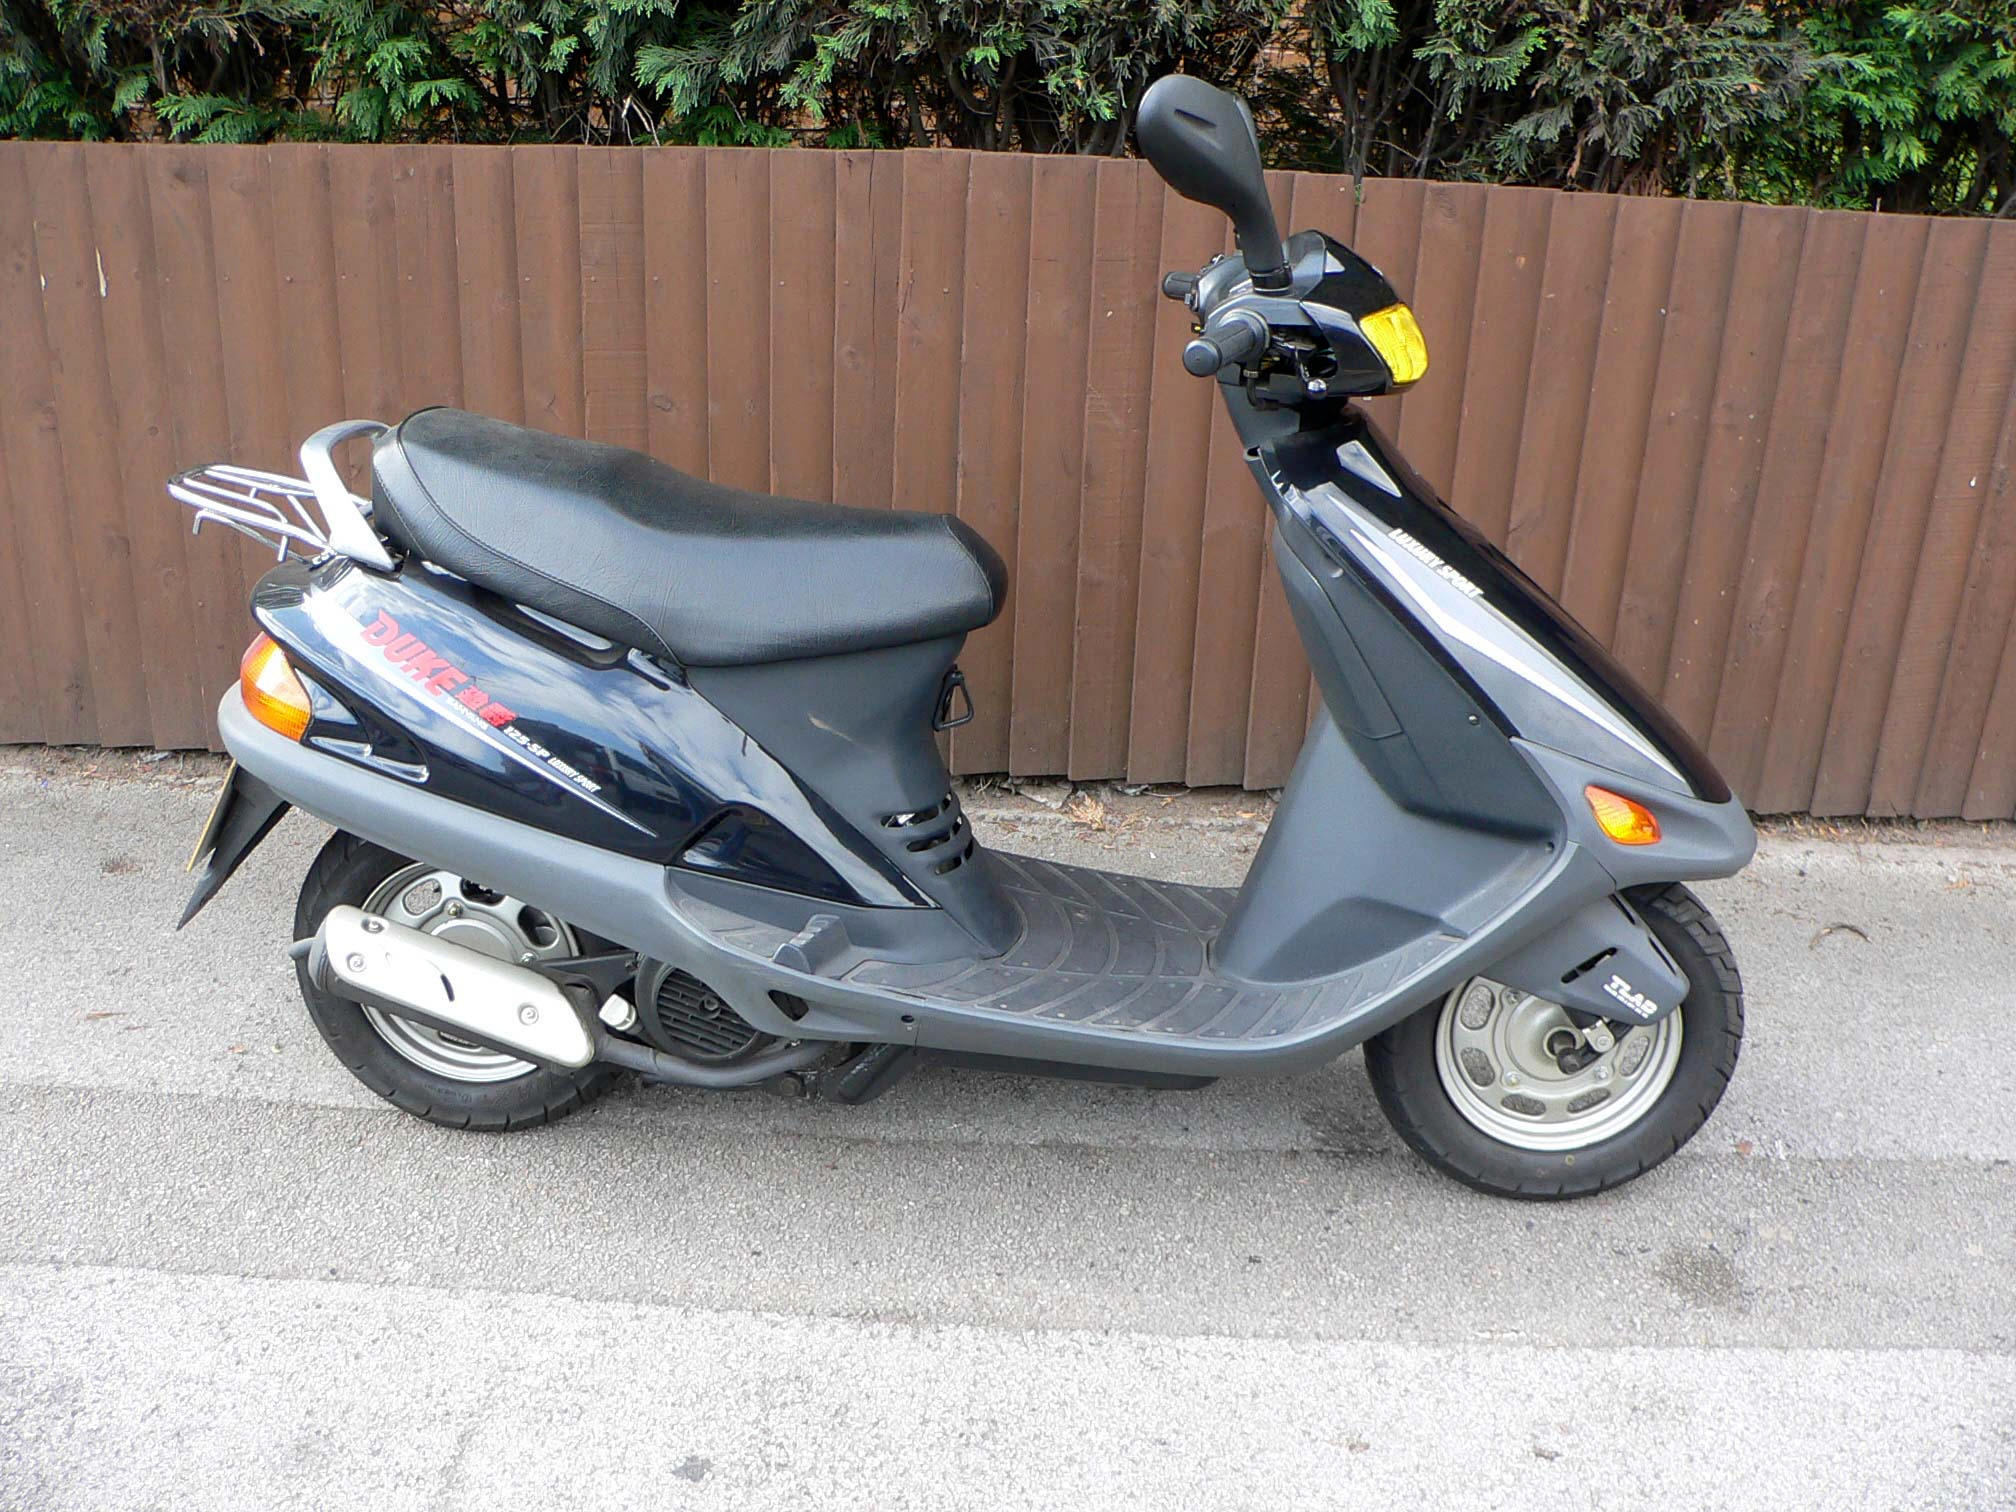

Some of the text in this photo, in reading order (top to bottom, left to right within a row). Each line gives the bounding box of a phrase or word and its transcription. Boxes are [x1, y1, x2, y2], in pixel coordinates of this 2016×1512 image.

[1387, 528, 1484, 599] LUXURY SPORT
[360, 608, 469, 697] DUKE
